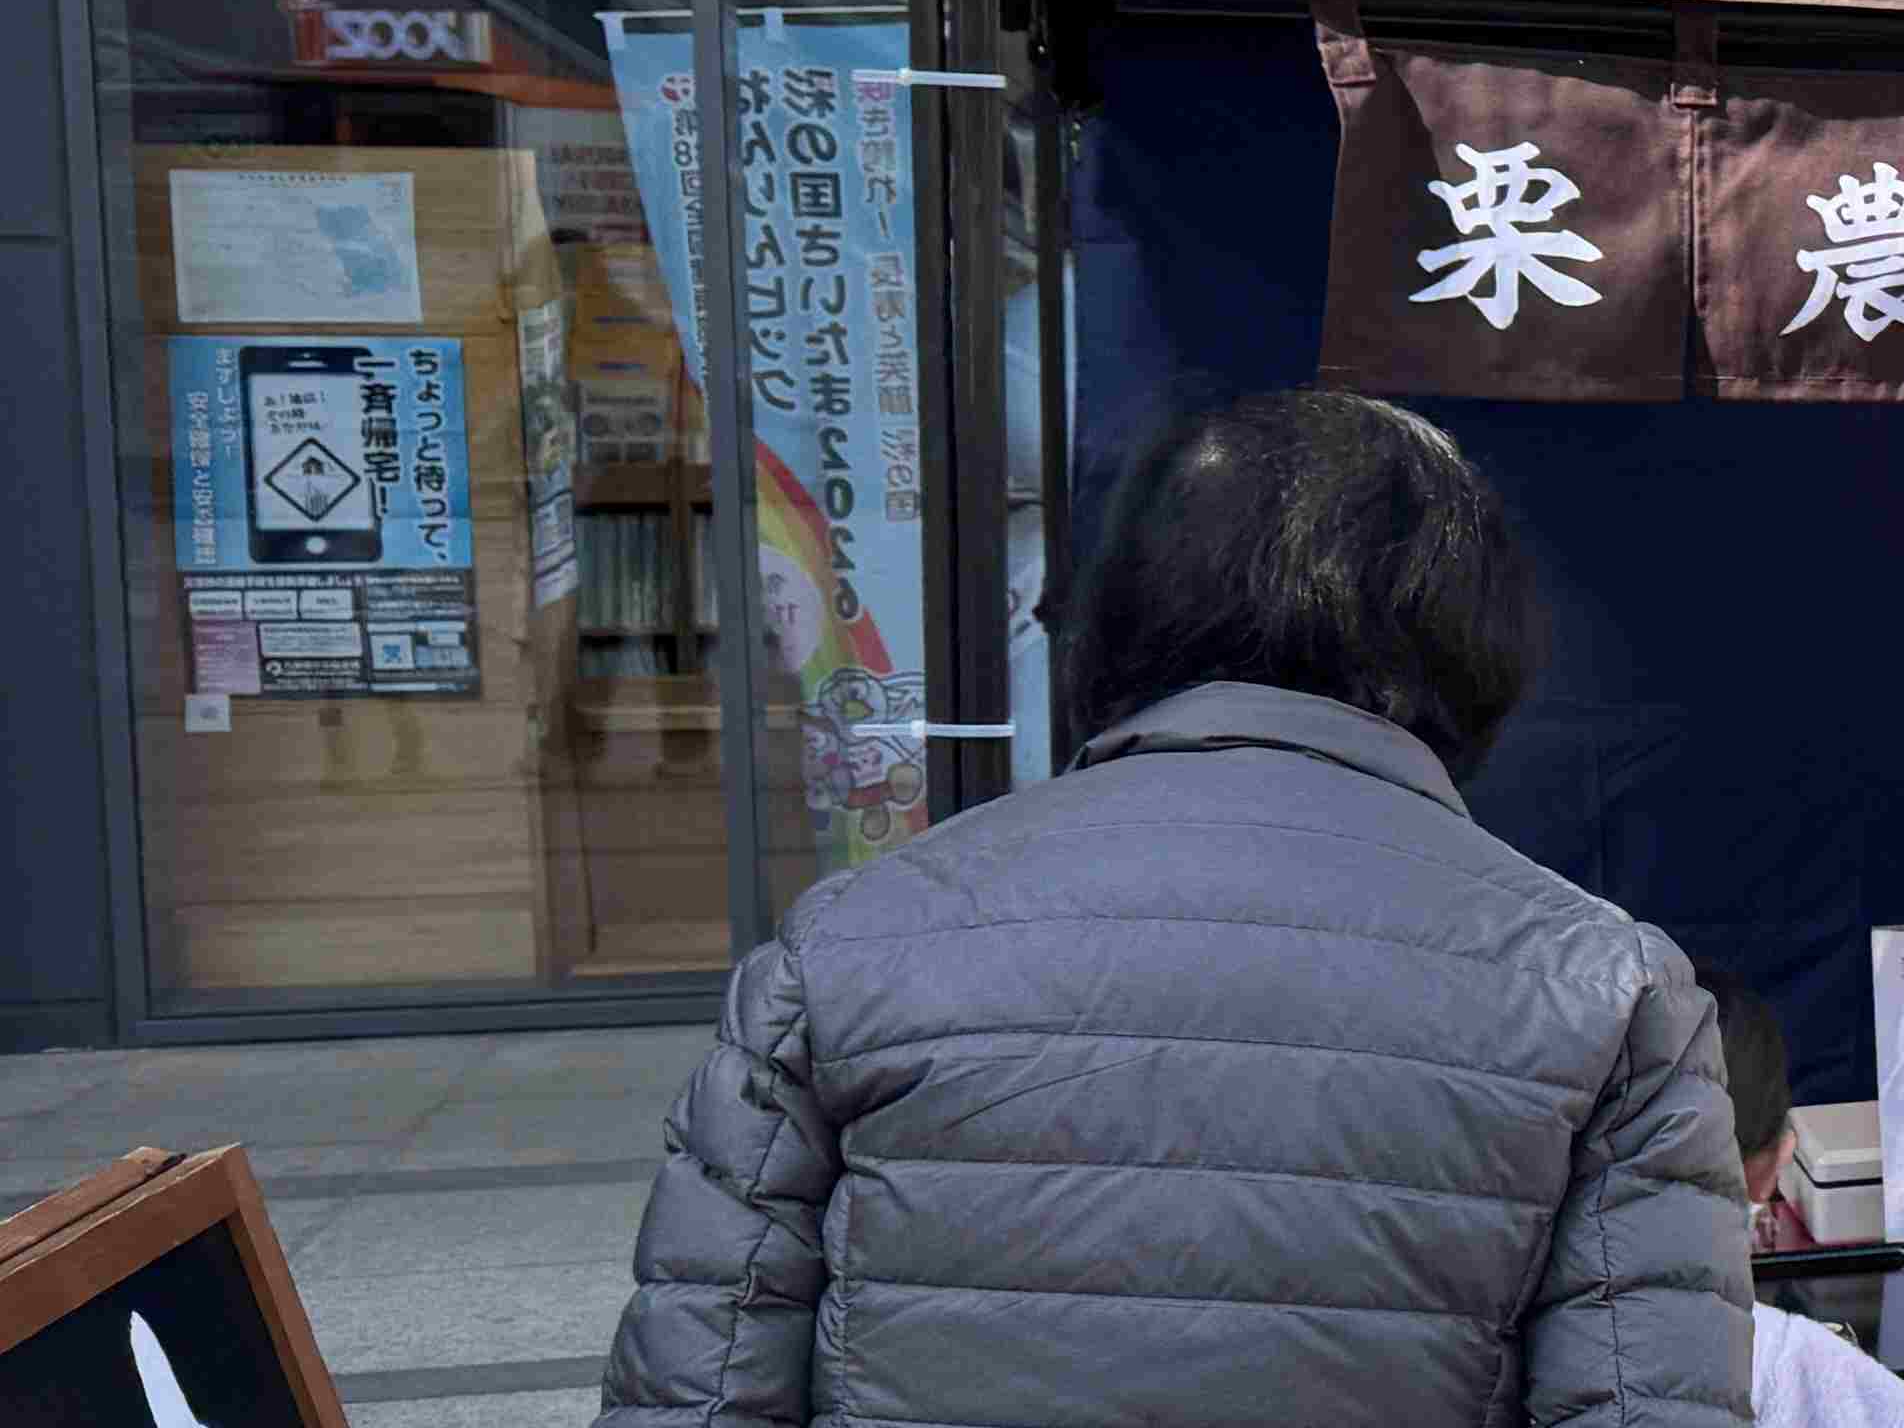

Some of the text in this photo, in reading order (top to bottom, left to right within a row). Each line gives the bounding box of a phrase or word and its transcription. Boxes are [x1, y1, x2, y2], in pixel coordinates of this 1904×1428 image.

[411, 347, 450, 561] ちょっと待って、
